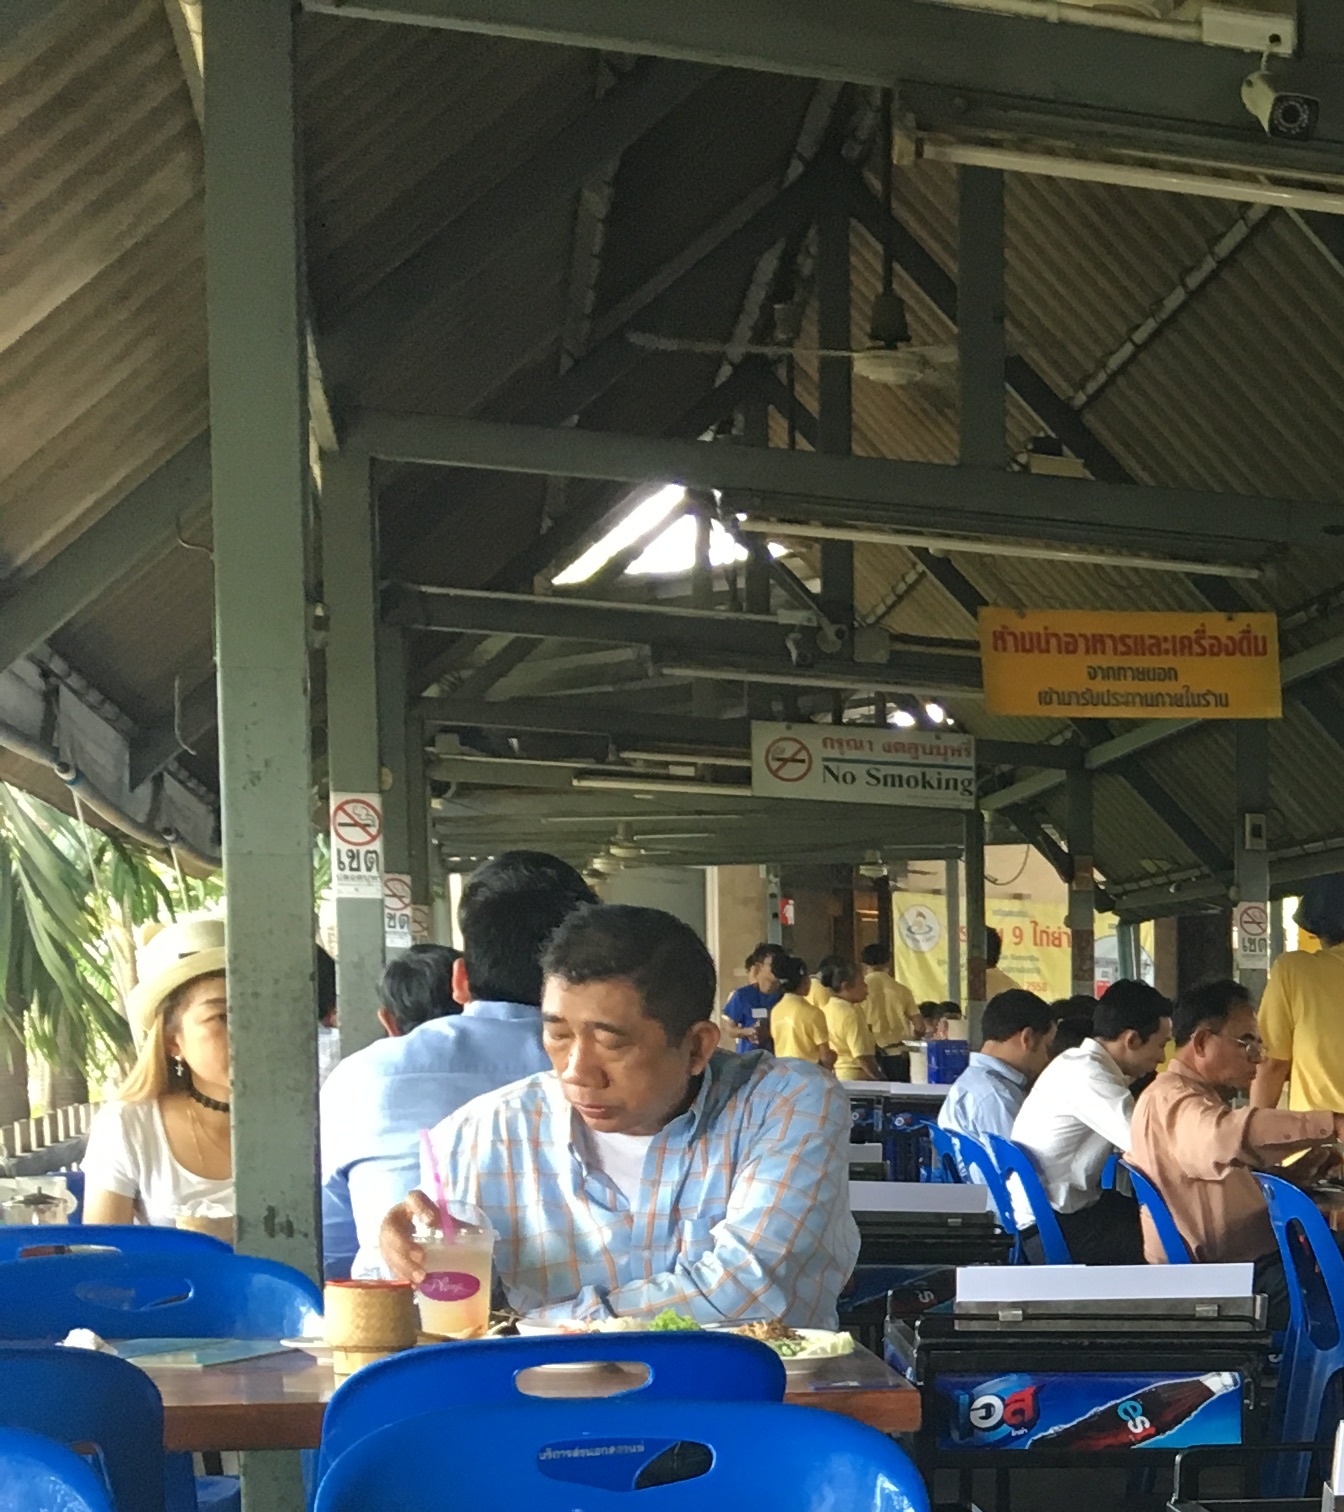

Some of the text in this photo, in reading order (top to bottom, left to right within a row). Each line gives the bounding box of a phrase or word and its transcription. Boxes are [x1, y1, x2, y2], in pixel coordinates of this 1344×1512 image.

[822, 764, 974, 797] No Smoking
[336, 848, 380, 872] เขต
[387, 911, 411, 929] ขต
[1030, 920, 1072, 949] ไก่ย่า
